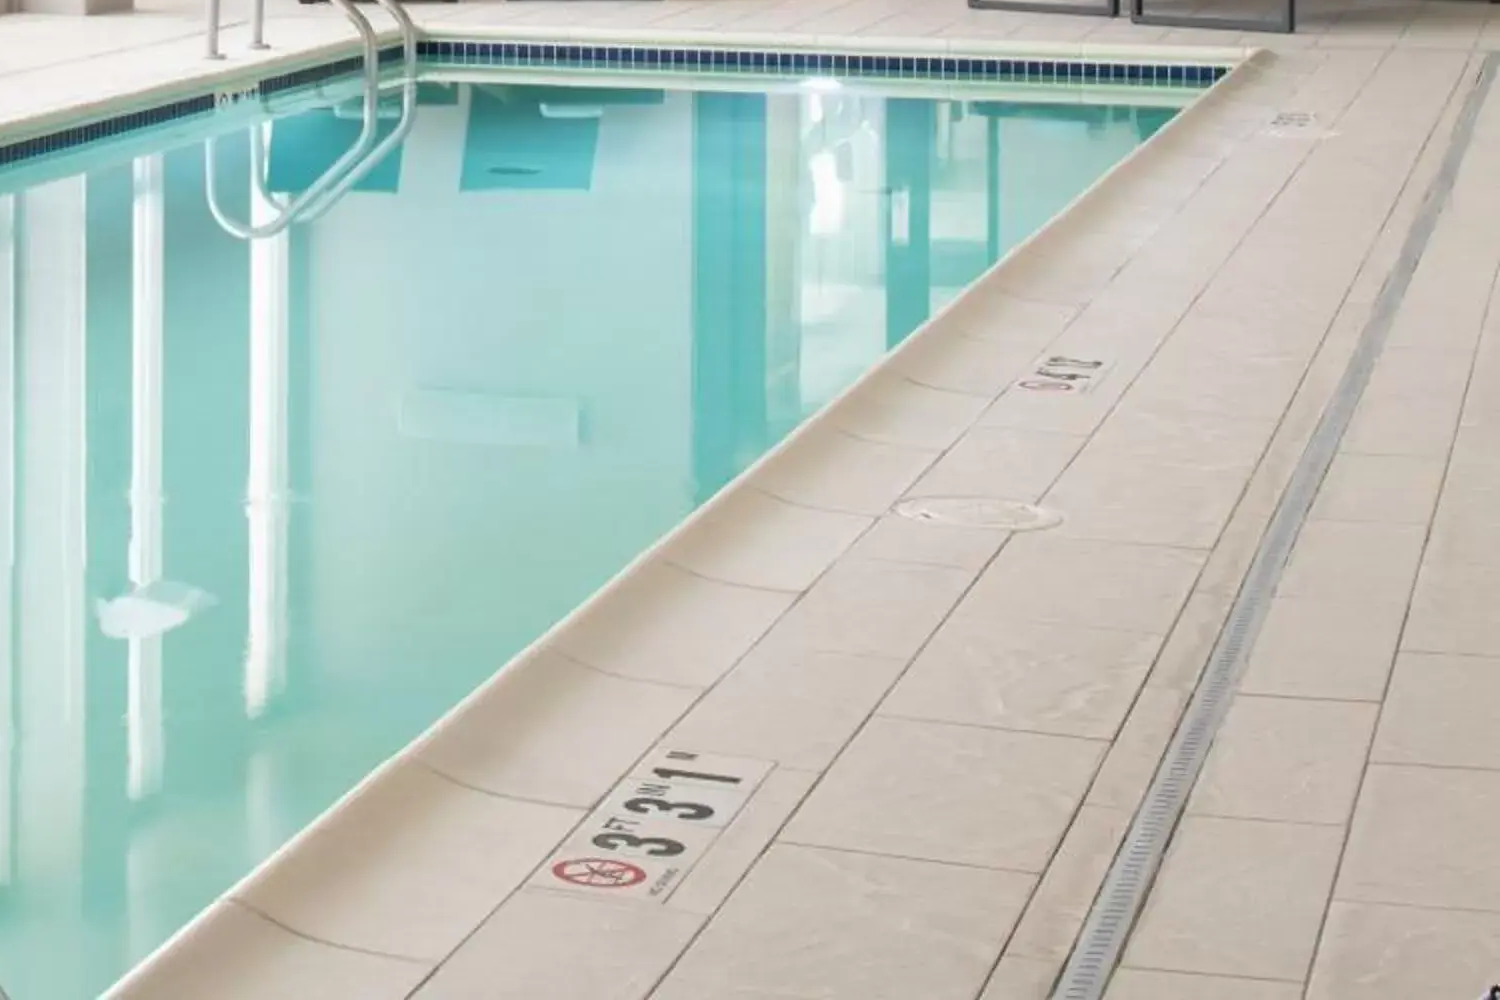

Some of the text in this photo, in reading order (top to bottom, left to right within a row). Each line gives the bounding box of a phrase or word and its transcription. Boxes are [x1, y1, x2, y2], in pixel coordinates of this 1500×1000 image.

[653, 768, 742, 784] 1
[624, 798, 714, 820] 3
[593, 833, 685, 856] 3
